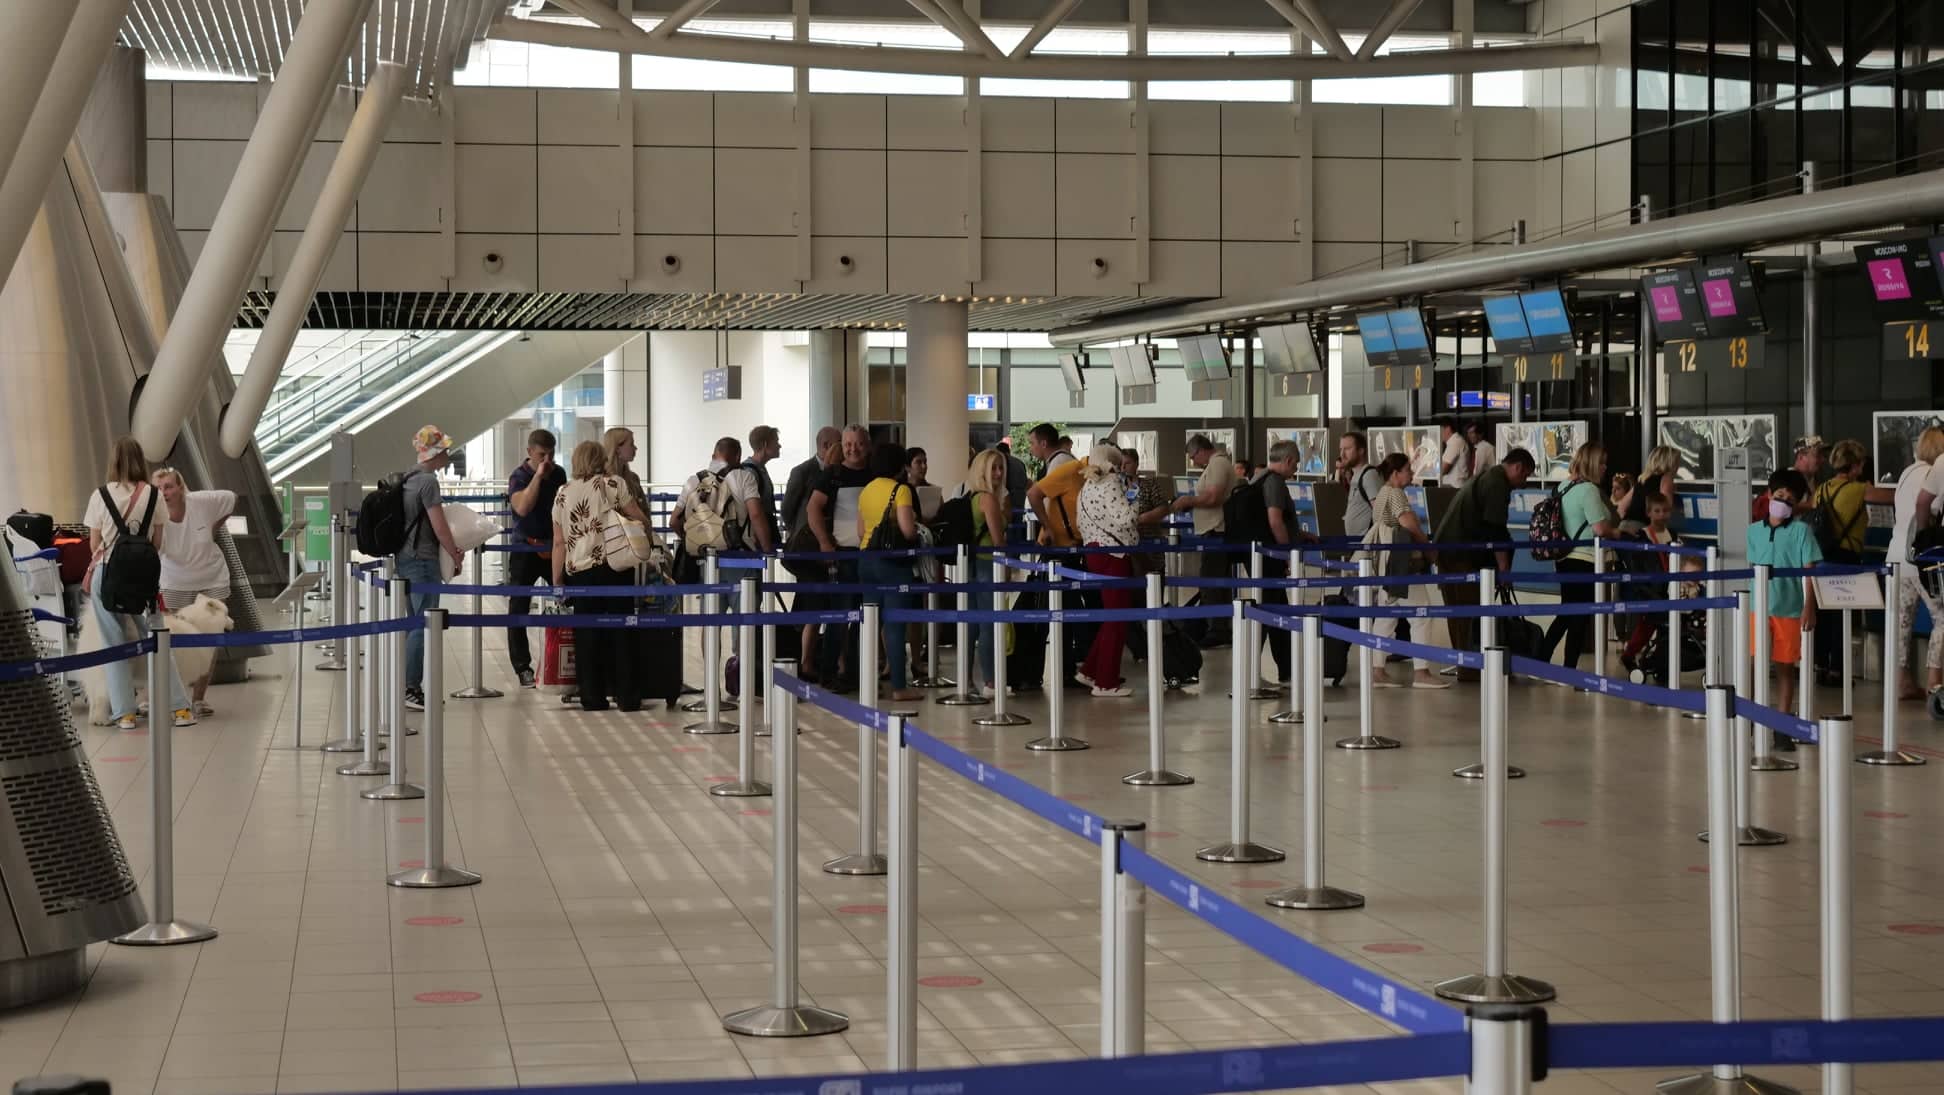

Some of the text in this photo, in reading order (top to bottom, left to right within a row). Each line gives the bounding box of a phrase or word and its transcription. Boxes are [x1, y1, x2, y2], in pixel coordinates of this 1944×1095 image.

[1729, 337, 1748, 368] 13
[1905, 324, 1929, 358] 14
[1514, 356, 1527, 382] 10
[1551, 353, 1563, 380] 11
[1679, 342, 1697, 372] 12
[1282, 375, 1289, 395] 6
[1306, 373, 1312, 394] 7
[1384, 367, 1392, 389] 8
[1414, 365, 1422, 388] 9
